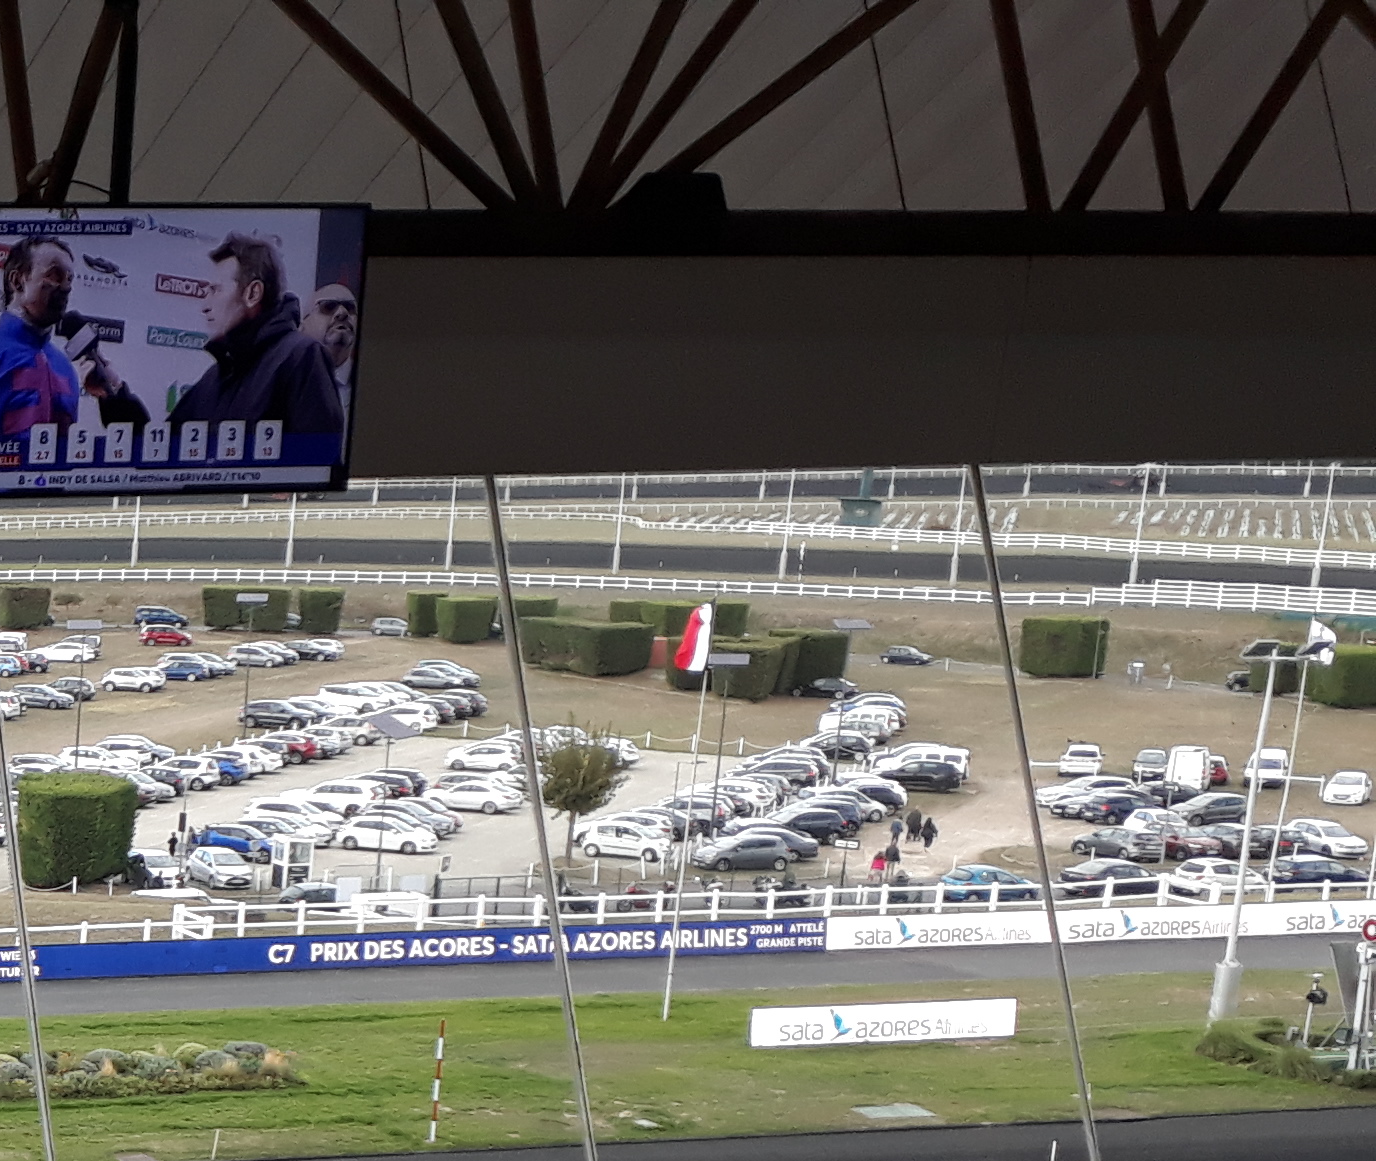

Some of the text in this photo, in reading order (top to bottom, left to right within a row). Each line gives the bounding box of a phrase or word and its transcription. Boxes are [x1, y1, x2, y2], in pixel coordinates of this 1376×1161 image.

[17, 224, 40, 233] SATA
[44, 224, 82, 233] AZORES
[84, 224, 126, 233] AIRLINES
[40, 428, 273, 444] 8 5 7 11 2 3 9
[49, 475, 120, 484] INDY DE SALSA
[751, 922, 824, 934] 2700 M ATTELÉ
[1068, 921, 1200, 939] sata azores
[1287, 914, 1325, 931] sata
[756, 937, 823, 948] GRANDE PISTE
[855, 928, 983, 945] sata azores
[269, 945, 295, 963] C7
[311, 942, 359, 962] PRIX
[364, 940, 404, 960] DES
[409, 937, 495, 958] ACORES
[513, 934, 569, 954] SATA
[574, 931, 655, 952] AZORES
[660, 927, 748, 949] AIRLINES
[0, 950, 36, 960] WIES
[780, 1020, 931, 1041] sata azores
